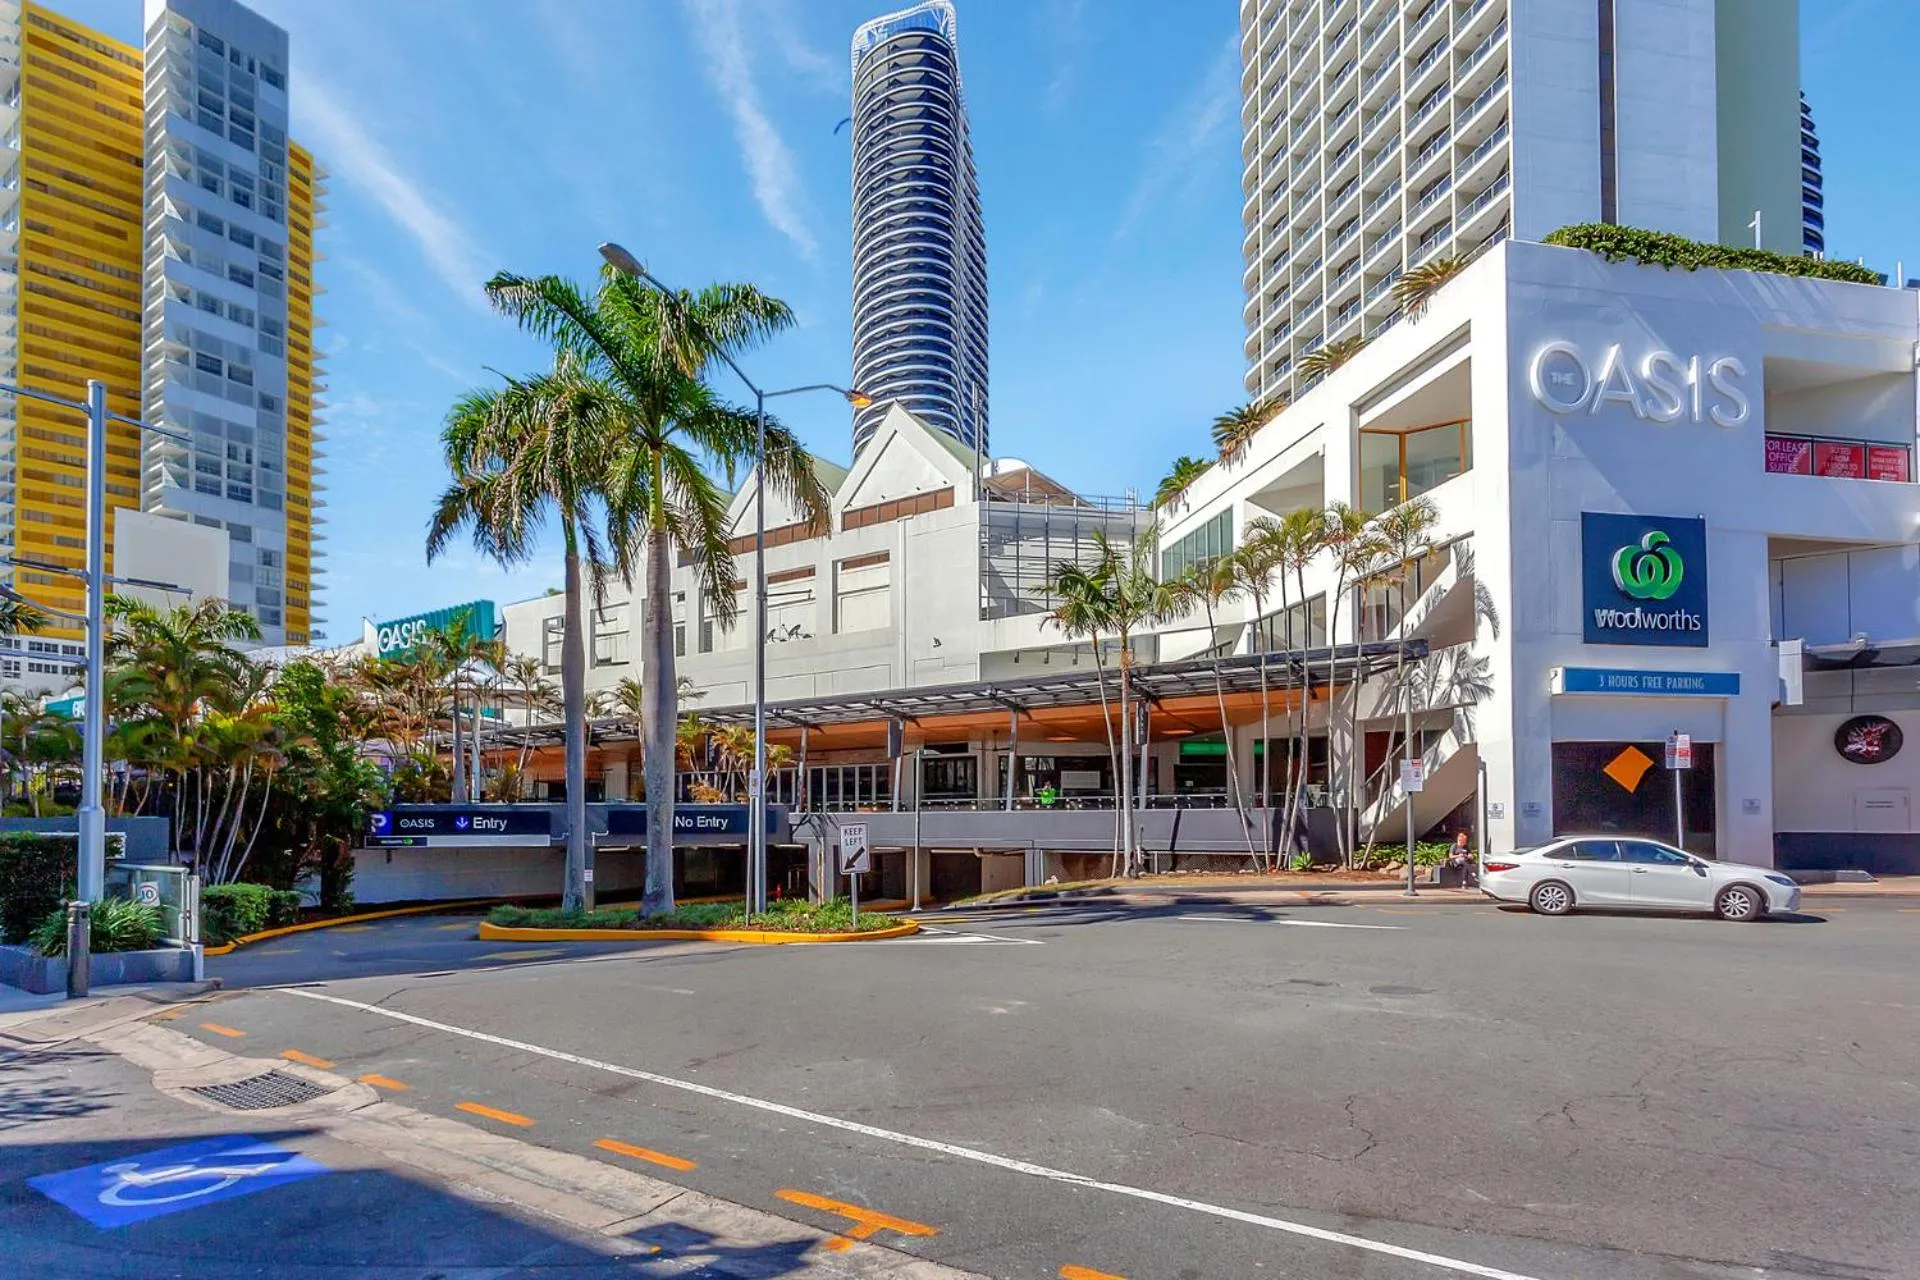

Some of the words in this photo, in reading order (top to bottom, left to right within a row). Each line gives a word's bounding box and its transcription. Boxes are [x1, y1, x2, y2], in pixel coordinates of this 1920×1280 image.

[1529, 340, 1749, 427] OASIS
[1550, 371, 1575, 386] THE
[1594, 607, 1701, 631] Woolworths
[1599, 675, 1605, 687] 3
[1608, 675, 1640, 689] HOURS
[1642, 676, 1664, 689] FREE
[1666, 677, 1705, 690] PARKING
[400, 817, 435, 829] OASIS
[472, 816, 507, 831] Entry
[675, 816, 694, 828] No
[696, 816, 728, 830] Entry
[844, 827, 863, 836] KEEP
[844, 836, 863, 846] LEFT
